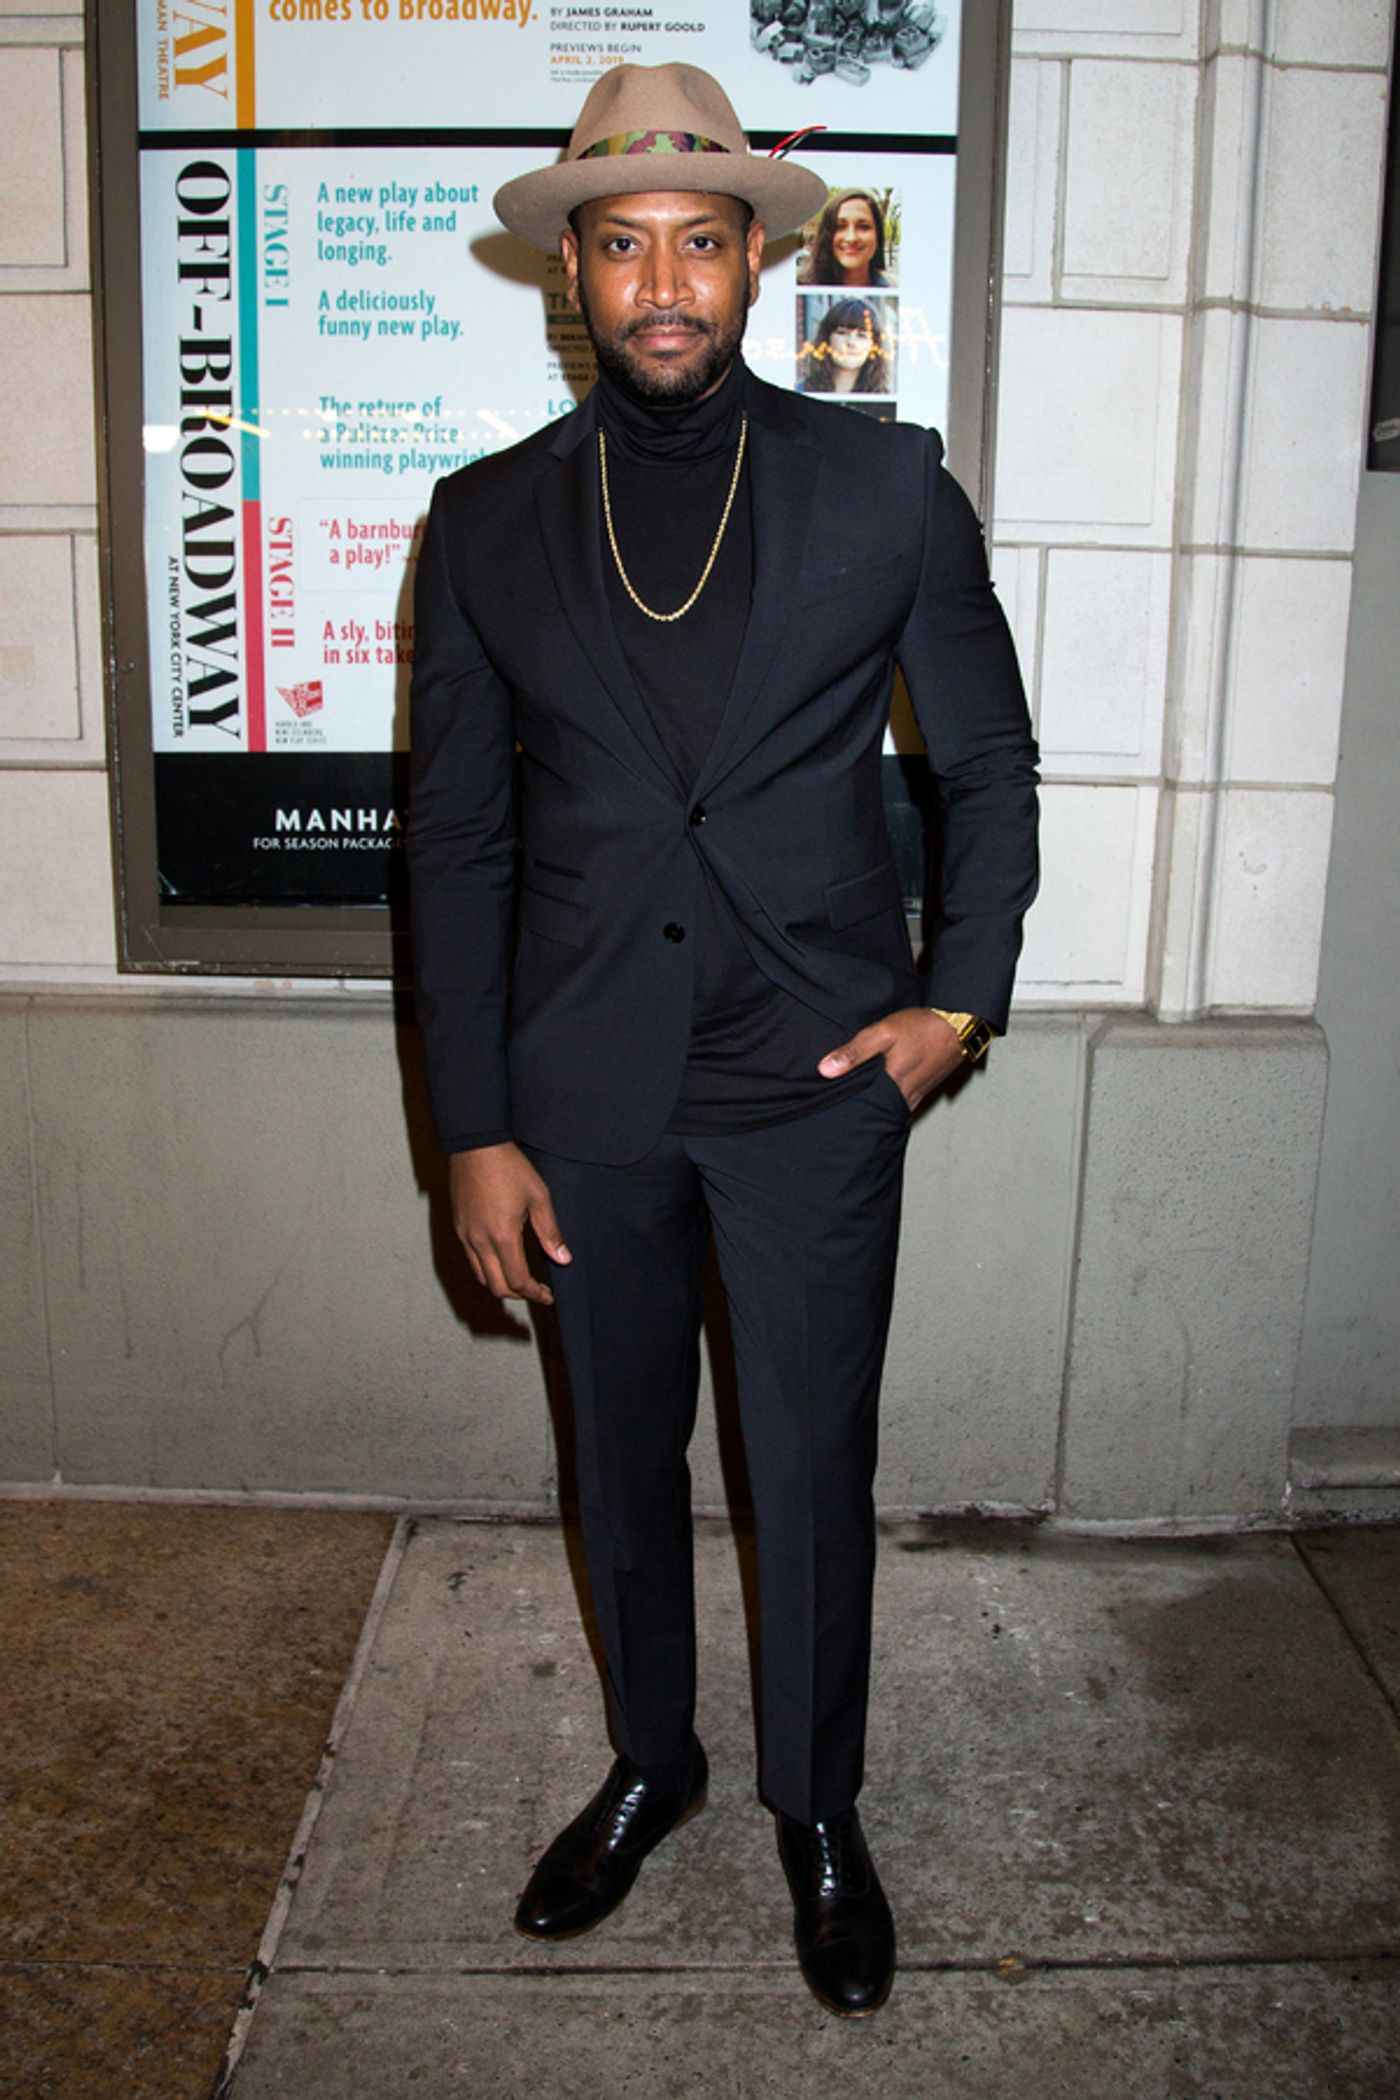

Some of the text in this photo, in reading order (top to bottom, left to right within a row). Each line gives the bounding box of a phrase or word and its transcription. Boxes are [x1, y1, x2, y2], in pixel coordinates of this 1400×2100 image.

[268, 0, 538, 28] comes to Broadway.
[550, 8, 653, 17] BY JAMES GRAHAM
[550, 22, 705, 32] DIRECTED BY RUPERT GOOLD
[173, 0, 227, 100] AY
[550, 43, 642, 53] PREVIEWS BEGIN
[550, 56, 582, 64] APRIL
[157, 39, 169, 99] THEATRE
[317, 180, 479, 208] A new play about
[317, 210, 456, 237] legacy, life and
[264, 184, 289, 307] STAGE I
[317, 240, 392, 267] longing.
[318, 289, 436, 316] A deliciously
[318, 315, 464, 341] funny new play.
[319, 396, 442, 418] The return of
[319, 427, 330, 443] a
[176, 160, 240, 740] OFF-BROADWAY
[319, 448, 394, 475] winning
[329, 549, 339, 564] a
[268, 517, 295, 647] STAGE II
[323, 620, 335, 641] A
[340, 620, 369, 646] sly,
[168, 556, 184, 738] AT NEW YORK CITY CENTER
[323, 644, 340, 664] in
[345, 644, 370, 664] six
[275, 808, 402, 832] MANHA
[253, 837, 281, 850] FOR
[284, 837, 339, 850] SEASON
